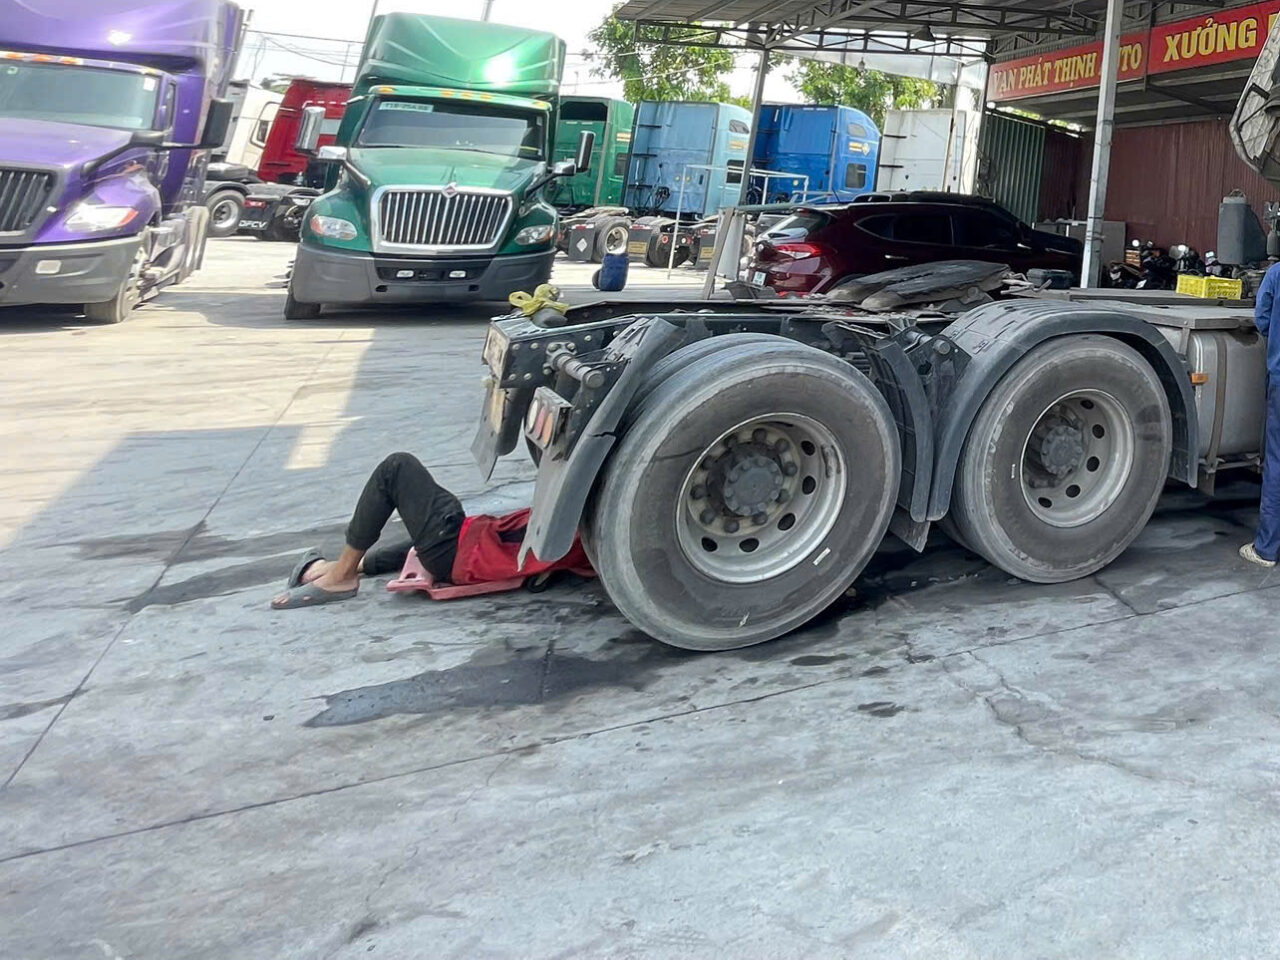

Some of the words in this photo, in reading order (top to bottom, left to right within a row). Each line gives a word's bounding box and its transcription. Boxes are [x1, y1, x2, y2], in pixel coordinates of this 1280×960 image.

[1163, 17, 1258, 62] XƯỞNG
[1018, 56, 1051, 88] PHÁT
[1053, 52, 1098, 87] THỊNH
